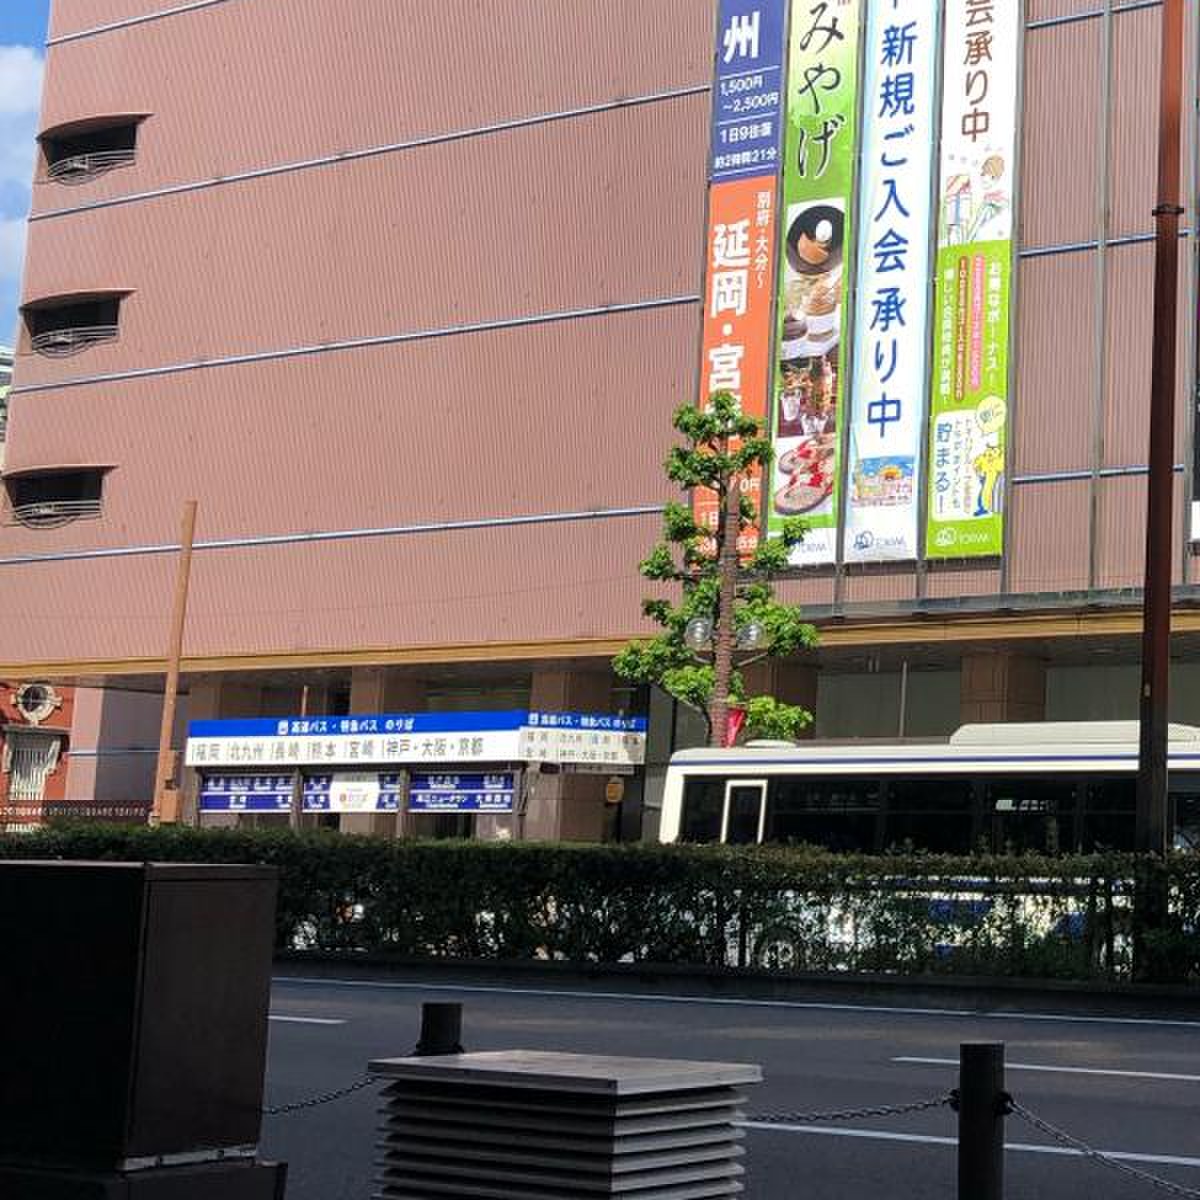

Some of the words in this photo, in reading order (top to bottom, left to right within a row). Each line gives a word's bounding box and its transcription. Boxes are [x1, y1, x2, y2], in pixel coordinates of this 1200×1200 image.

[720, 75, 763, 97] 1,500円
[705, 218, 751, 422] 延岡・宮
